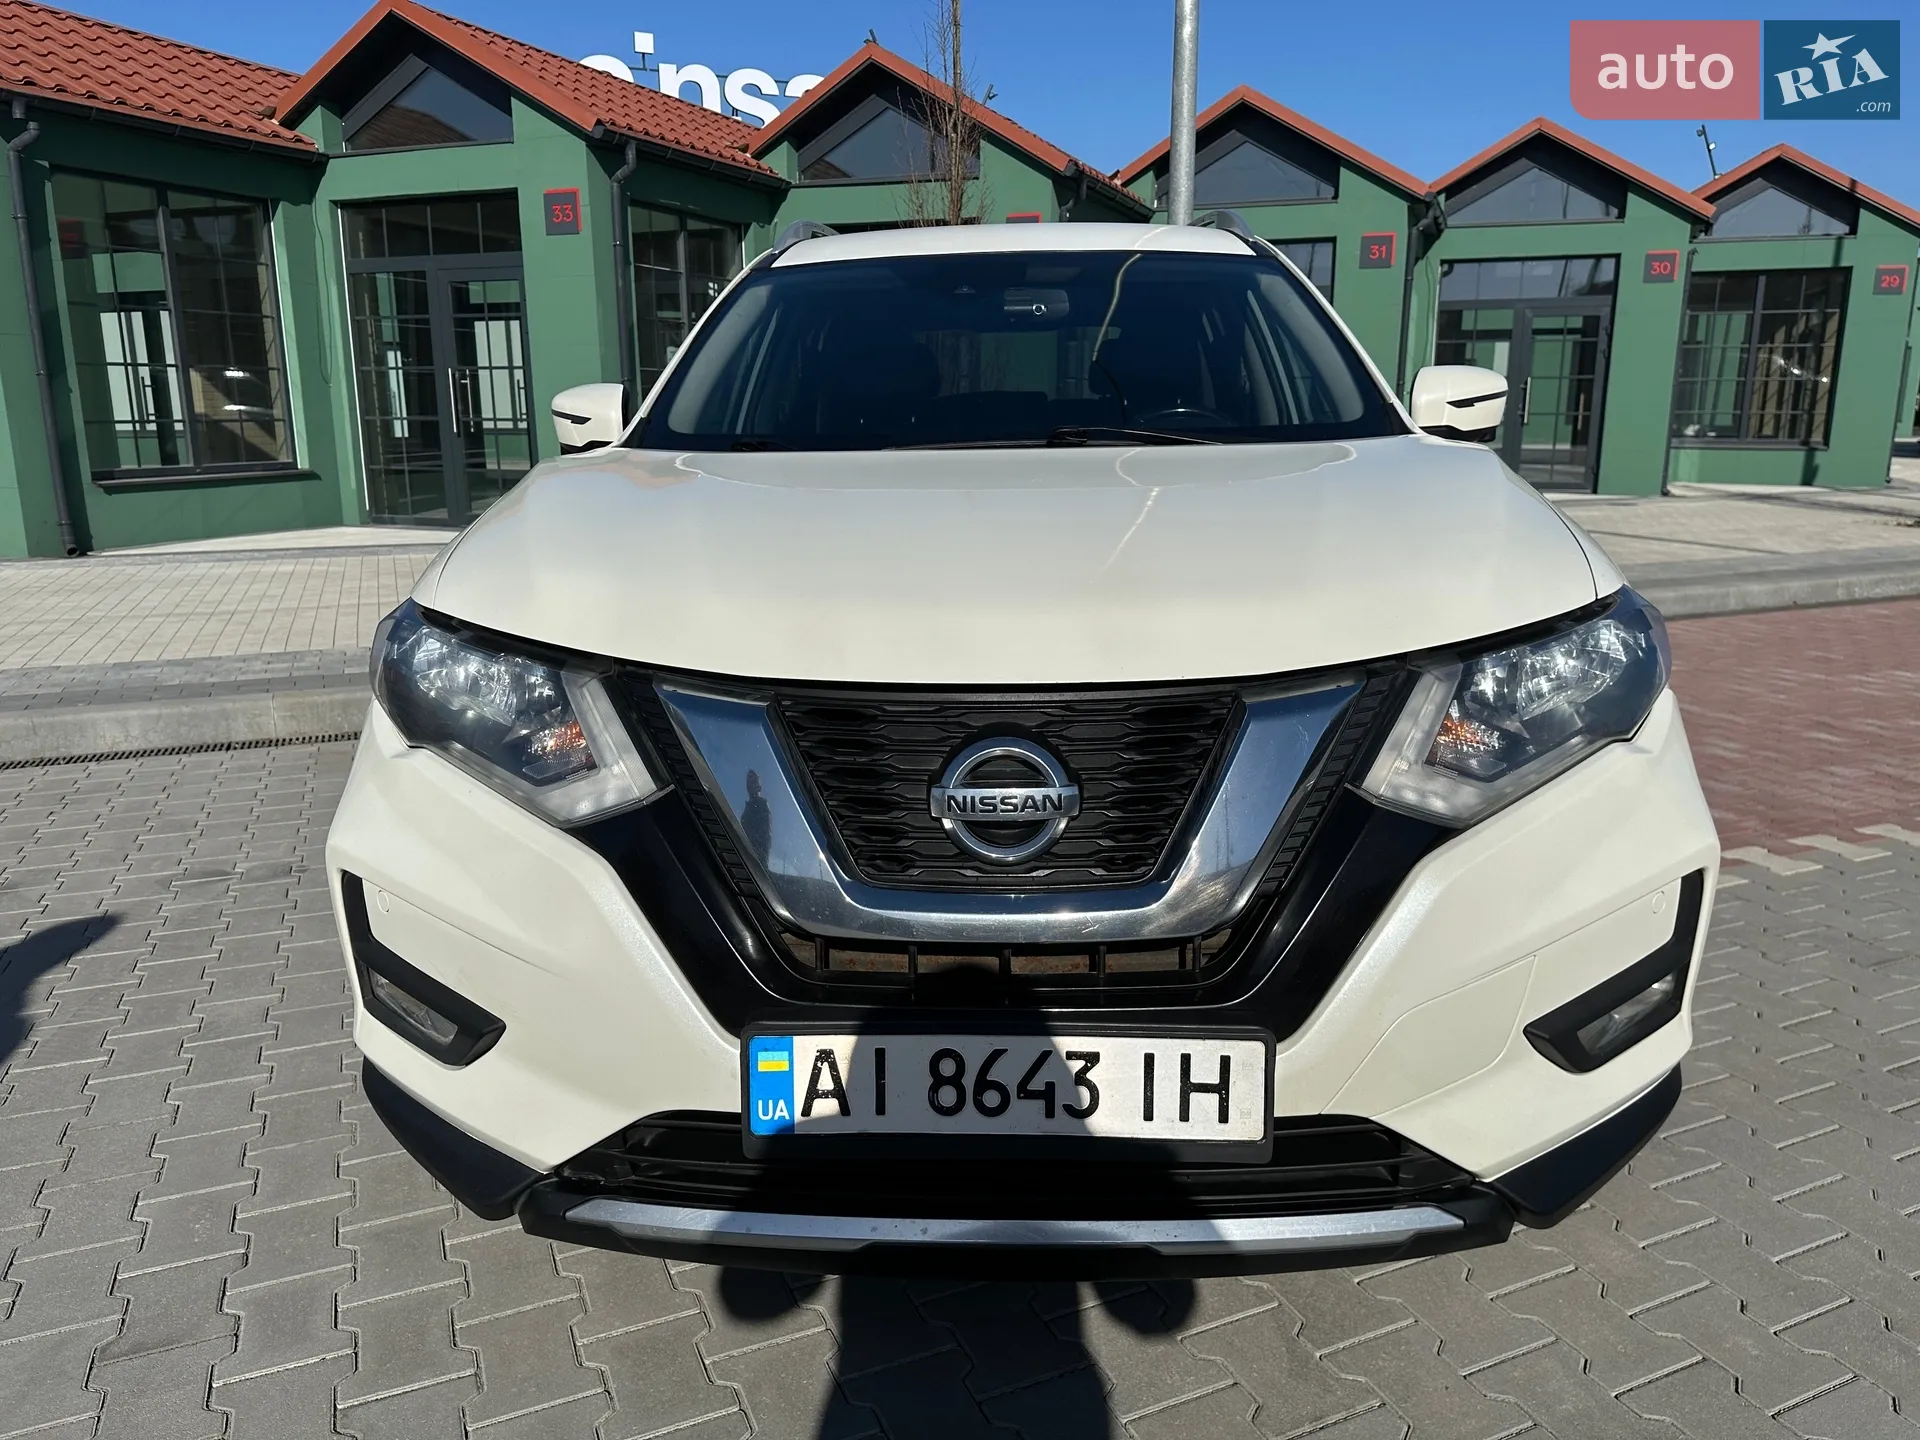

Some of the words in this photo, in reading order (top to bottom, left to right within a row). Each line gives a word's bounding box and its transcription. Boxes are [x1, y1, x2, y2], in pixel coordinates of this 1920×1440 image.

[552, 205, 573, 223] 33
[1369, 244, 1387, 260] 31
[1650, 261, 1671, 275] 30
[1880, 275, 1900, 288] 29
[946, 793, 1063, 814] NISSAN
[800, 1047, 886, 1117] AI
[927, 1047, 1101, 1119] 8643
[1143, 1052, 1231, 1124] IH
[757, 1099, 790, 1120] UA
